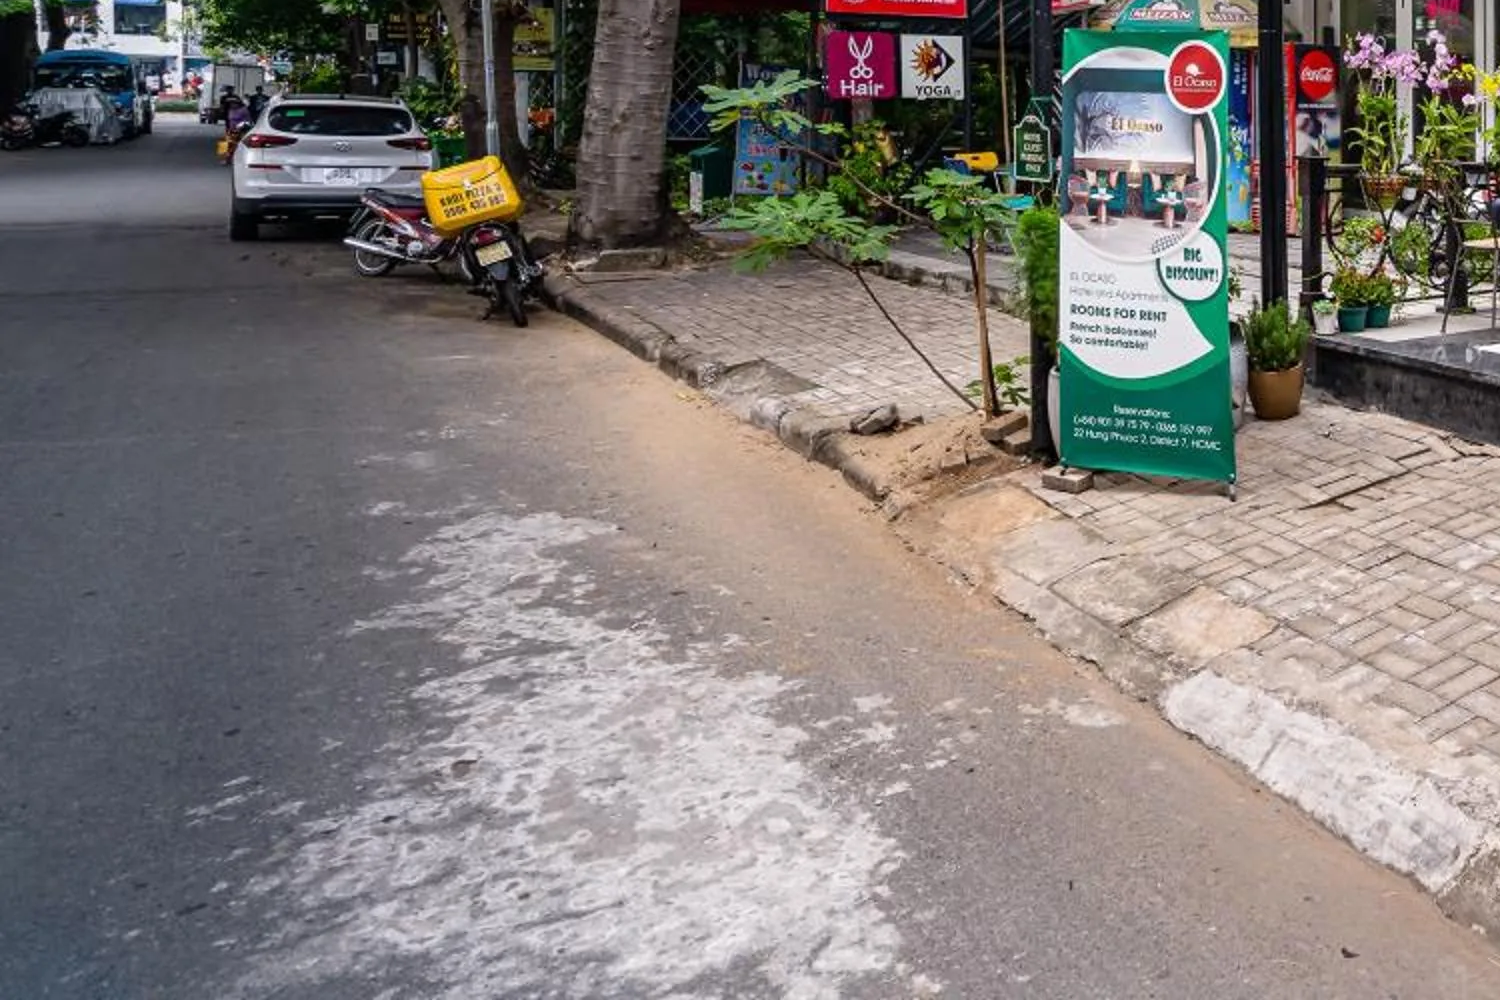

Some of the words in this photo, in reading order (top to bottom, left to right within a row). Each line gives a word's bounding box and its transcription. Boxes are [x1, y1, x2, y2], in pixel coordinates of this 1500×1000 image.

[1132, 8, 1192, 20] MEIZAN
[841, 79, 884, 97] Hair
[915, 84, 951, 96] YOGA
[1183, 247, 1203, 262] BIG
[1165, 265, 1219, 283] DISCOUNT!
[1070, 304, 1111, 318] ROOMS
[1113, 307, 1136, 319] FOR
[1139, 310, 1168, 322] RENT
[1069, 334, 1083, 344] So
